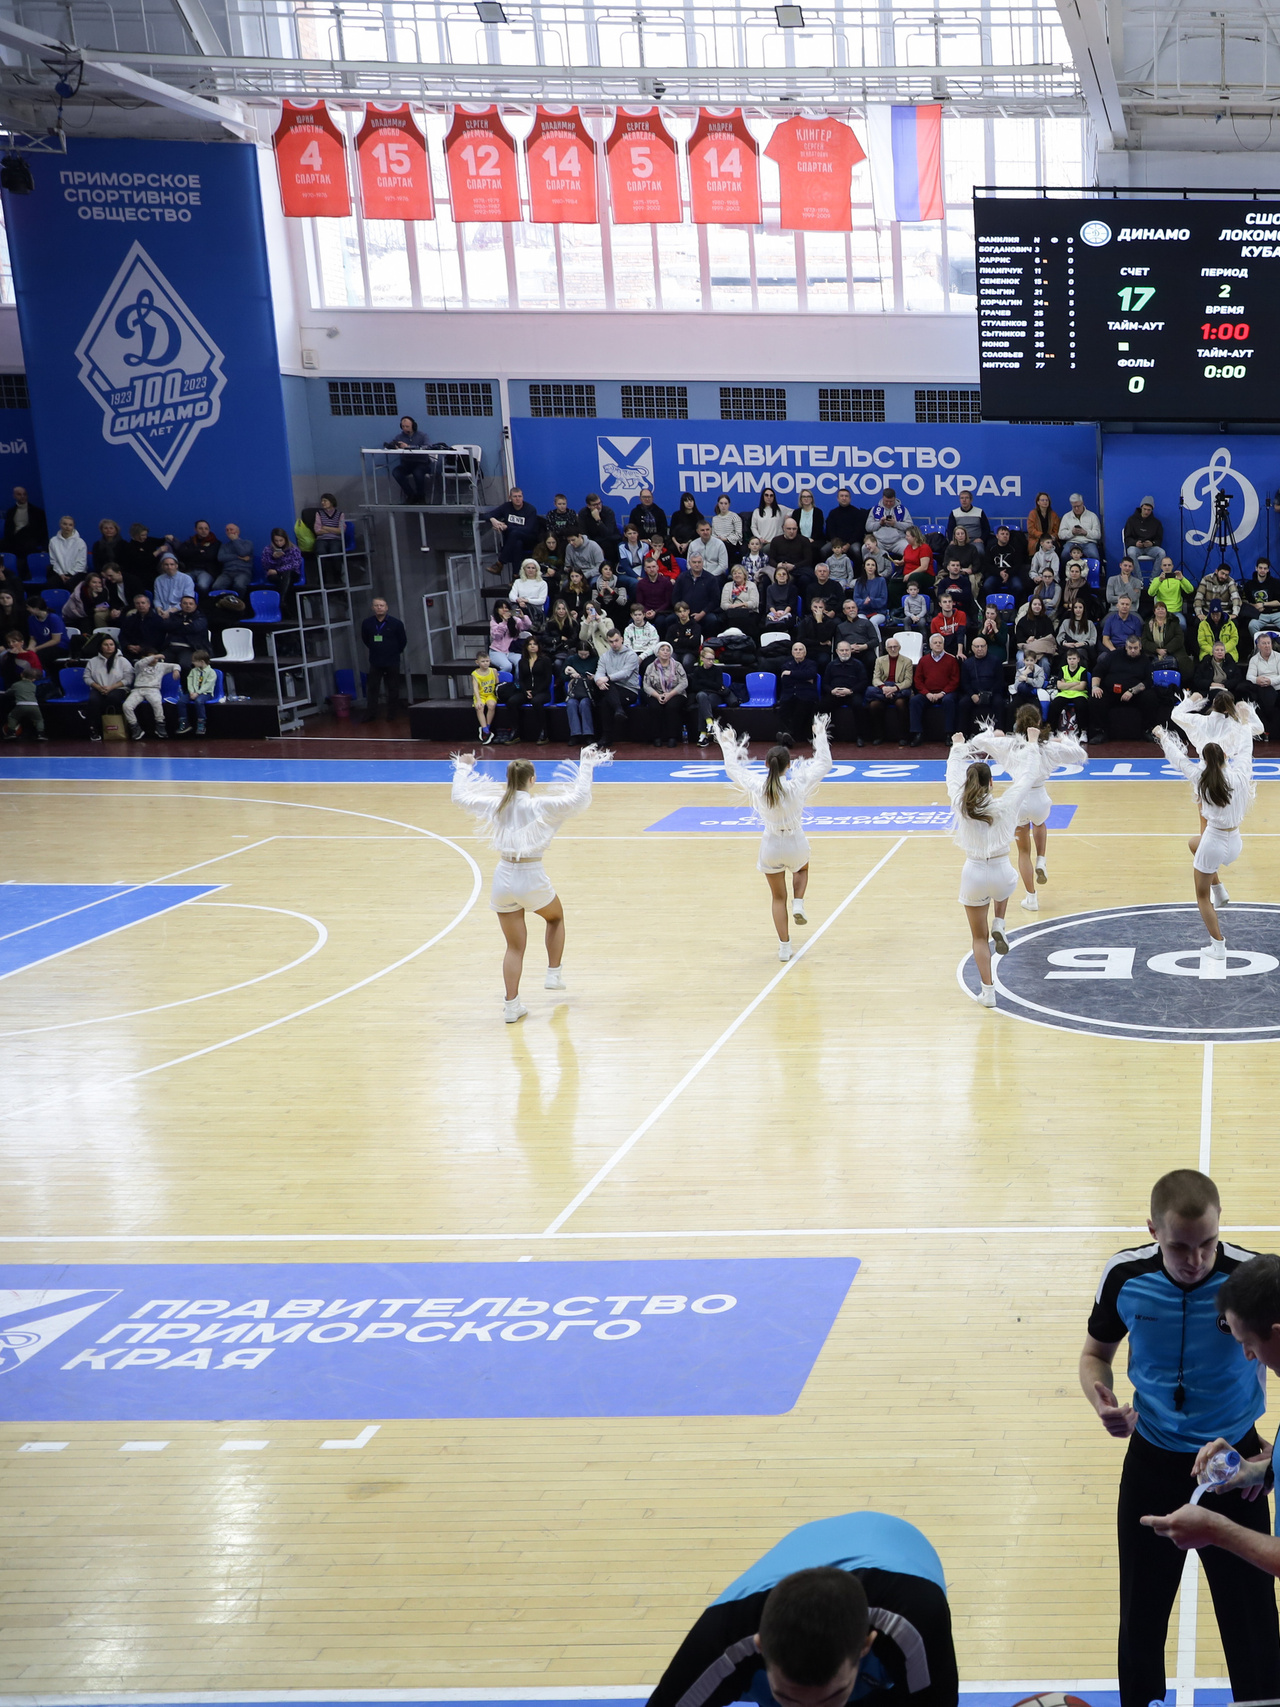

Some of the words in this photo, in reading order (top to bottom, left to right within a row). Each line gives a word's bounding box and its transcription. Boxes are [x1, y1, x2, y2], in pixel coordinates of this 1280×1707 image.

[299, 140, 323, 171] 4
[371, 143, 411, 174] 15
[460, 145, 501, 176] 12
[542, 146, 581, 178] 14
[630, 147, 654, 178] 5
[703, 148, 743, 178] 14
[797, 161, 833, 173] СПАРТАК
[59, 170, 201, 188] ПРИМОРСКОЕ
[295, 174, 331, 185] СПАРТАК
[377, 177, 413, 188] СПАРТАК
[466, 180, 502, 190] СПАРТАК
[546, 180, 581, 191] СПАРТАК
[627, 181, 662, 192] СПАРТАК
[707, 181, 742, 192] СПАРТАК
[63, 188, 201, 206] СПОРТИВНОЕ
[77, 205, 192, 223] ОБЩЕСТВО
[978, 236, 1020, 244] ФАМИЛИЯ
[1117, 228, 1191, 242] ДИНАМО
[978, 246, 1033, 254] БОГДАНОВИЧ
[979, 256, 1011, 264] ХАРРИС
[1119, 267, 1150, 276] СЧЕТ
[1201, 268, 1248, 279] ПЕРИОД
[1033, 288, 1043, 296] 21
[1218, 284, 1231, 298] 2
[1117, 286, 1156, 311] 17
[1205, 305, 1245, 315] ВРЕМЯ
[1107, 320, 1165, 331] ТАЙМ-АУТ
[1200, 323, 1250, 341] 1:00
[1197, 348, 1254, 358] ТАЙМ-АУТ
[1117, 359, 1155, 368] ФОЛЫ
[1204, 365, 1246, 379] 0:00
[110, 390, 132, 406] 1923
[183, 376, 208, 392] 2023
[1128, 376, 1145, 393] 0
[113, 400, 209, 433] ДИНАМО
[149, 425, 174, 437] ЛЕТ
[676, 443, 961, 469] ПРАВИТЕЛЬСТВО
[678, 470, 924, 497] ПРИМОРСКОГО
[934, 474, 1021, 498] КРАЯ
[127, 1293, 739, 1320] ПРАВИТЕЛЬСТВО
[94, 1317, 644, 1345] ПРИМОРСКОГО
[59, 1347, 277, 1371] КРАЯ
